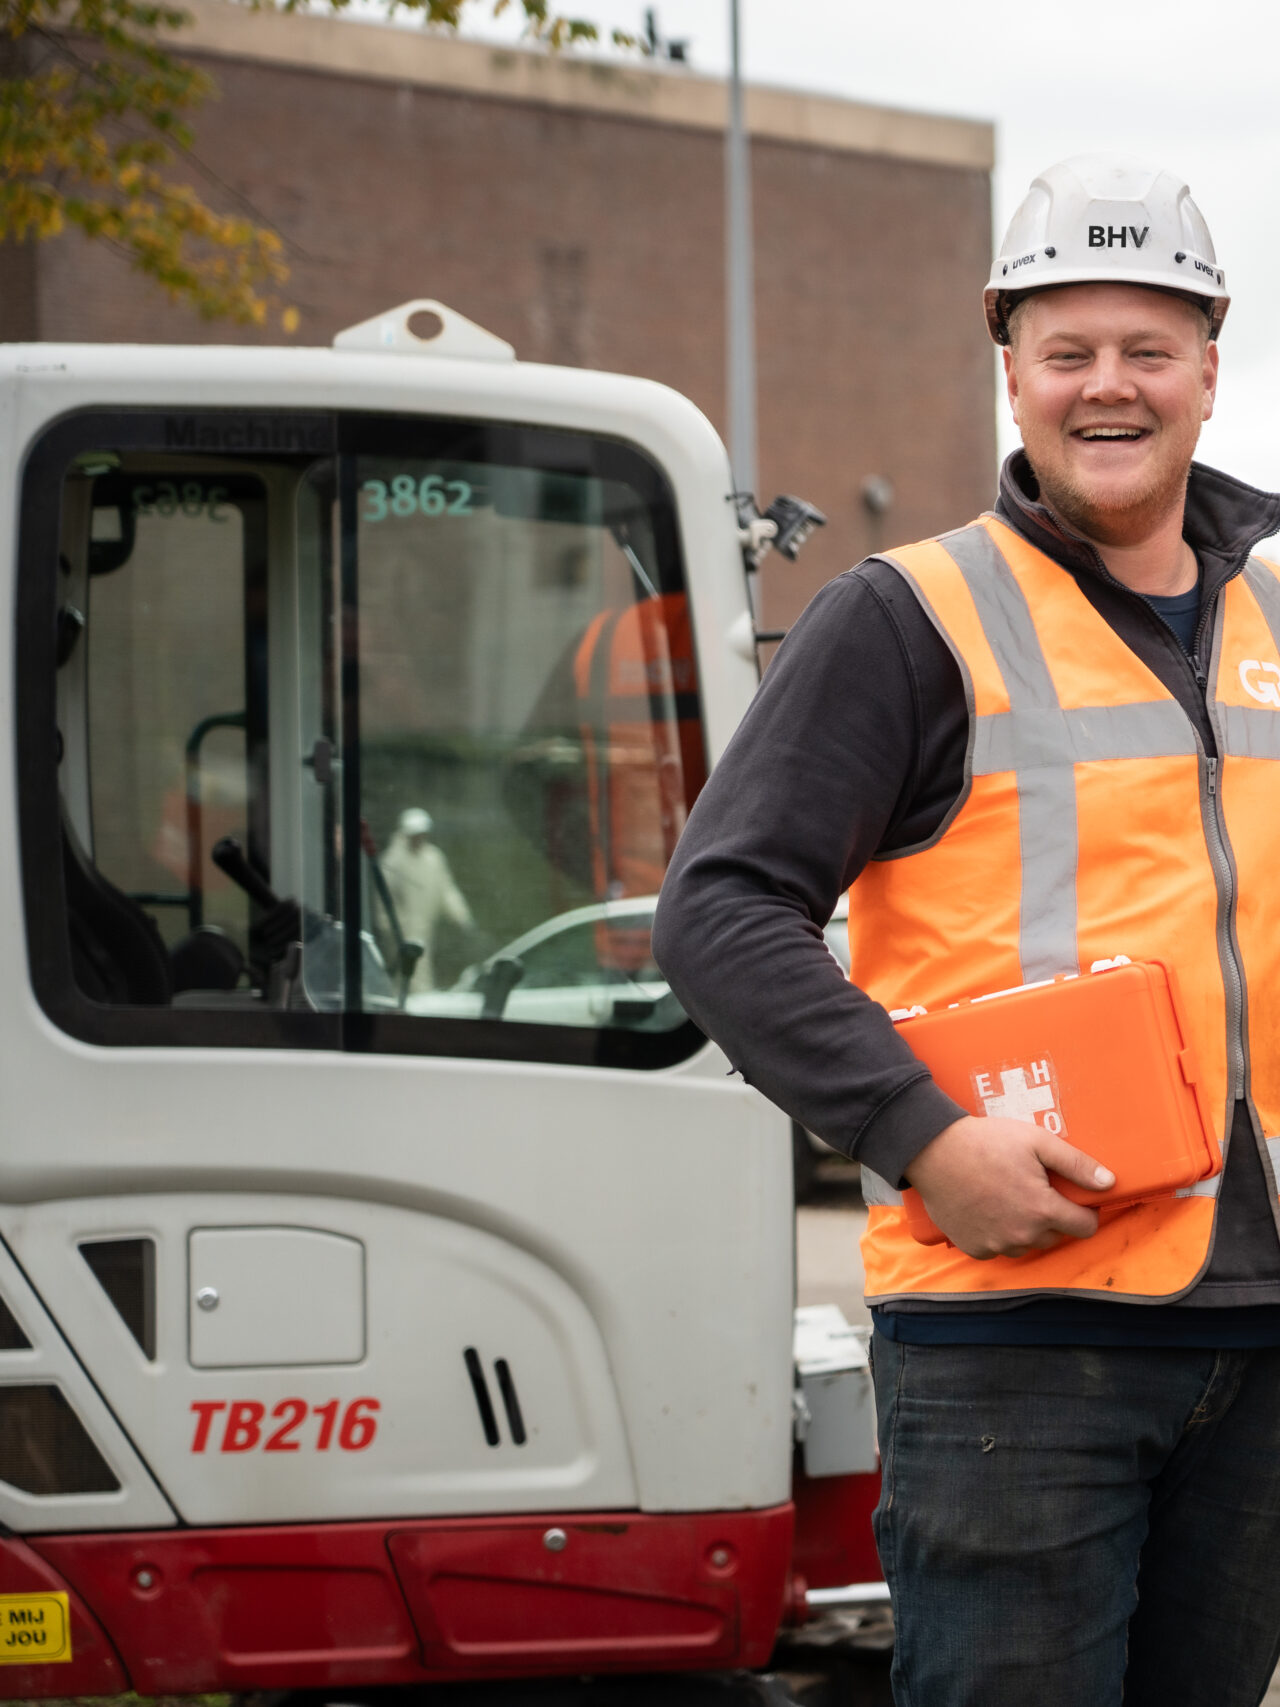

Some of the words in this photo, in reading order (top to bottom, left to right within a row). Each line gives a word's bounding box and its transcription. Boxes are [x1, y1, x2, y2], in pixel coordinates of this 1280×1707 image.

[1088, 225, 1149, 248] BHV
[1012, 253, 1036, 270] uvex
[1194, 259, 1214, 277] uvex
[362, 474, 474, 522] 3862
[190, 1397, 381, 1453] TB216
[9, 1608, 44, 1625] MIJ
[6, 1629, 46, 1647] JOU
